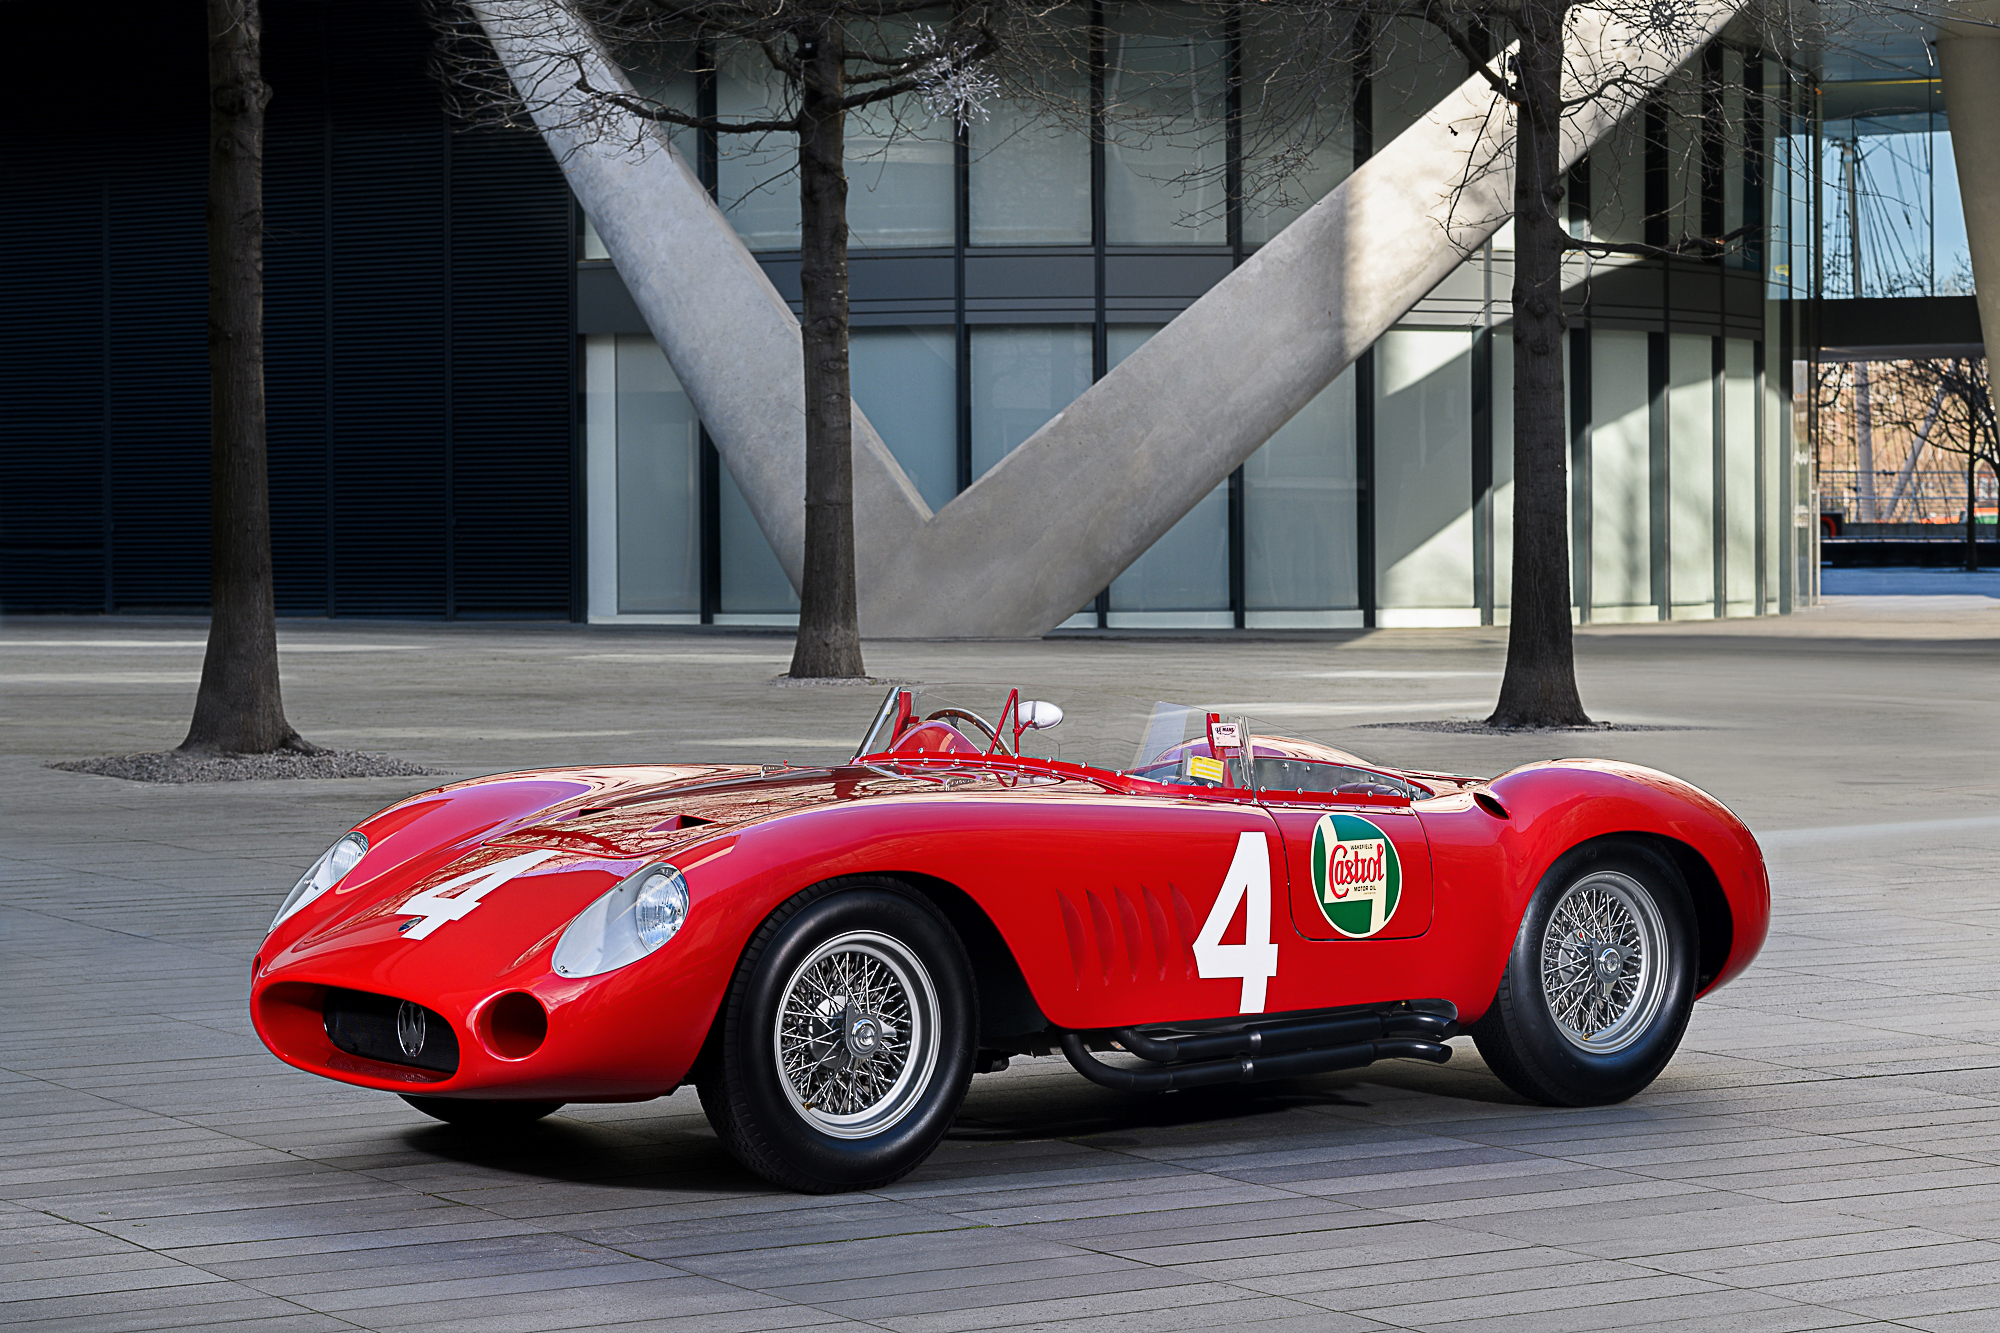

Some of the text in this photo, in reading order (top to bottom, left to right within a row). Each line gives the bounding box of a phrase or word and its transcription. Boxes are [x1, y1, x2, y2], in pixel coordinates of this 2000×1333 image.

[394, 849, 563, 941] 4
[1329, 844, 1384, 899] Castrol
[1192, 831, 1278, 1014] 4
